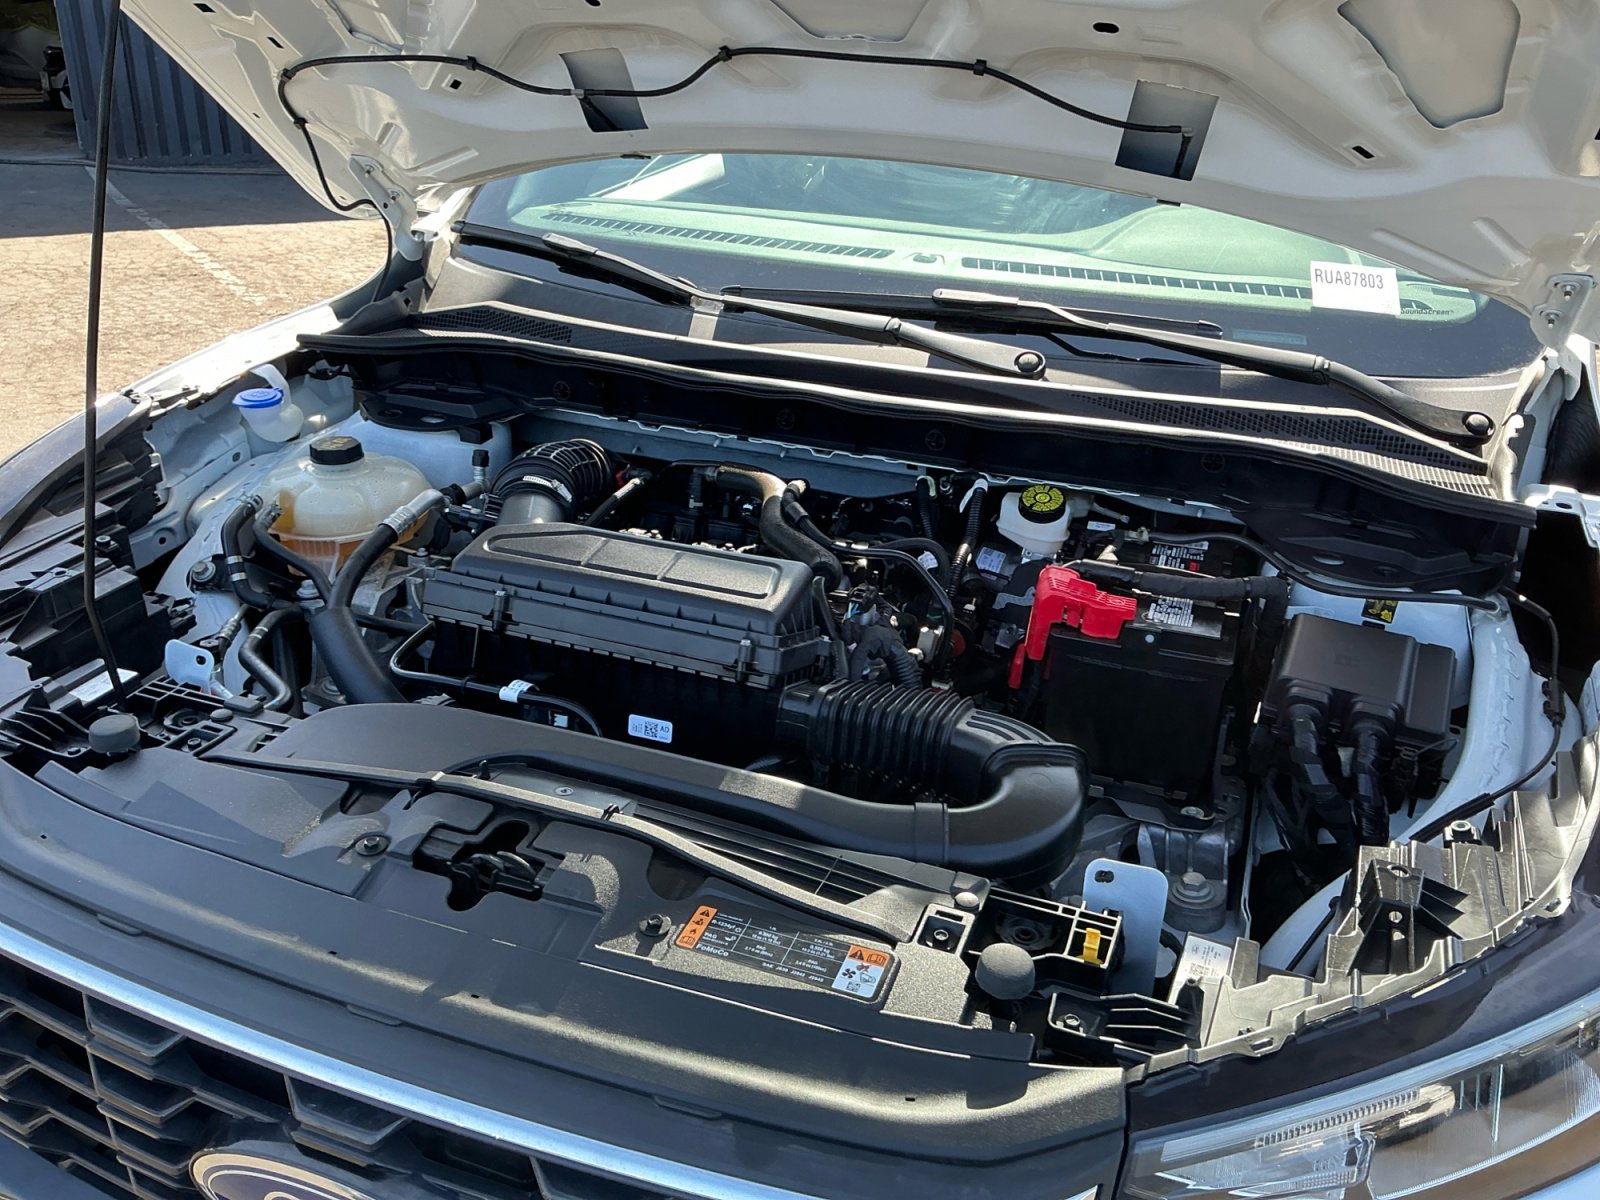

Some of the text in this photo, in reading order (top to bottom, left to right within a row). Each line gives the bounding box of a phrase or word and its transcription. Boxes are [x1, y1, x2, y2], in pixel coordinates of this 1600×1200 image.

[1314, 268, 1384, 290] RUA87803
[659, 725, 670, 734] AD
[695, 943, 729, 957] FoMoCo
